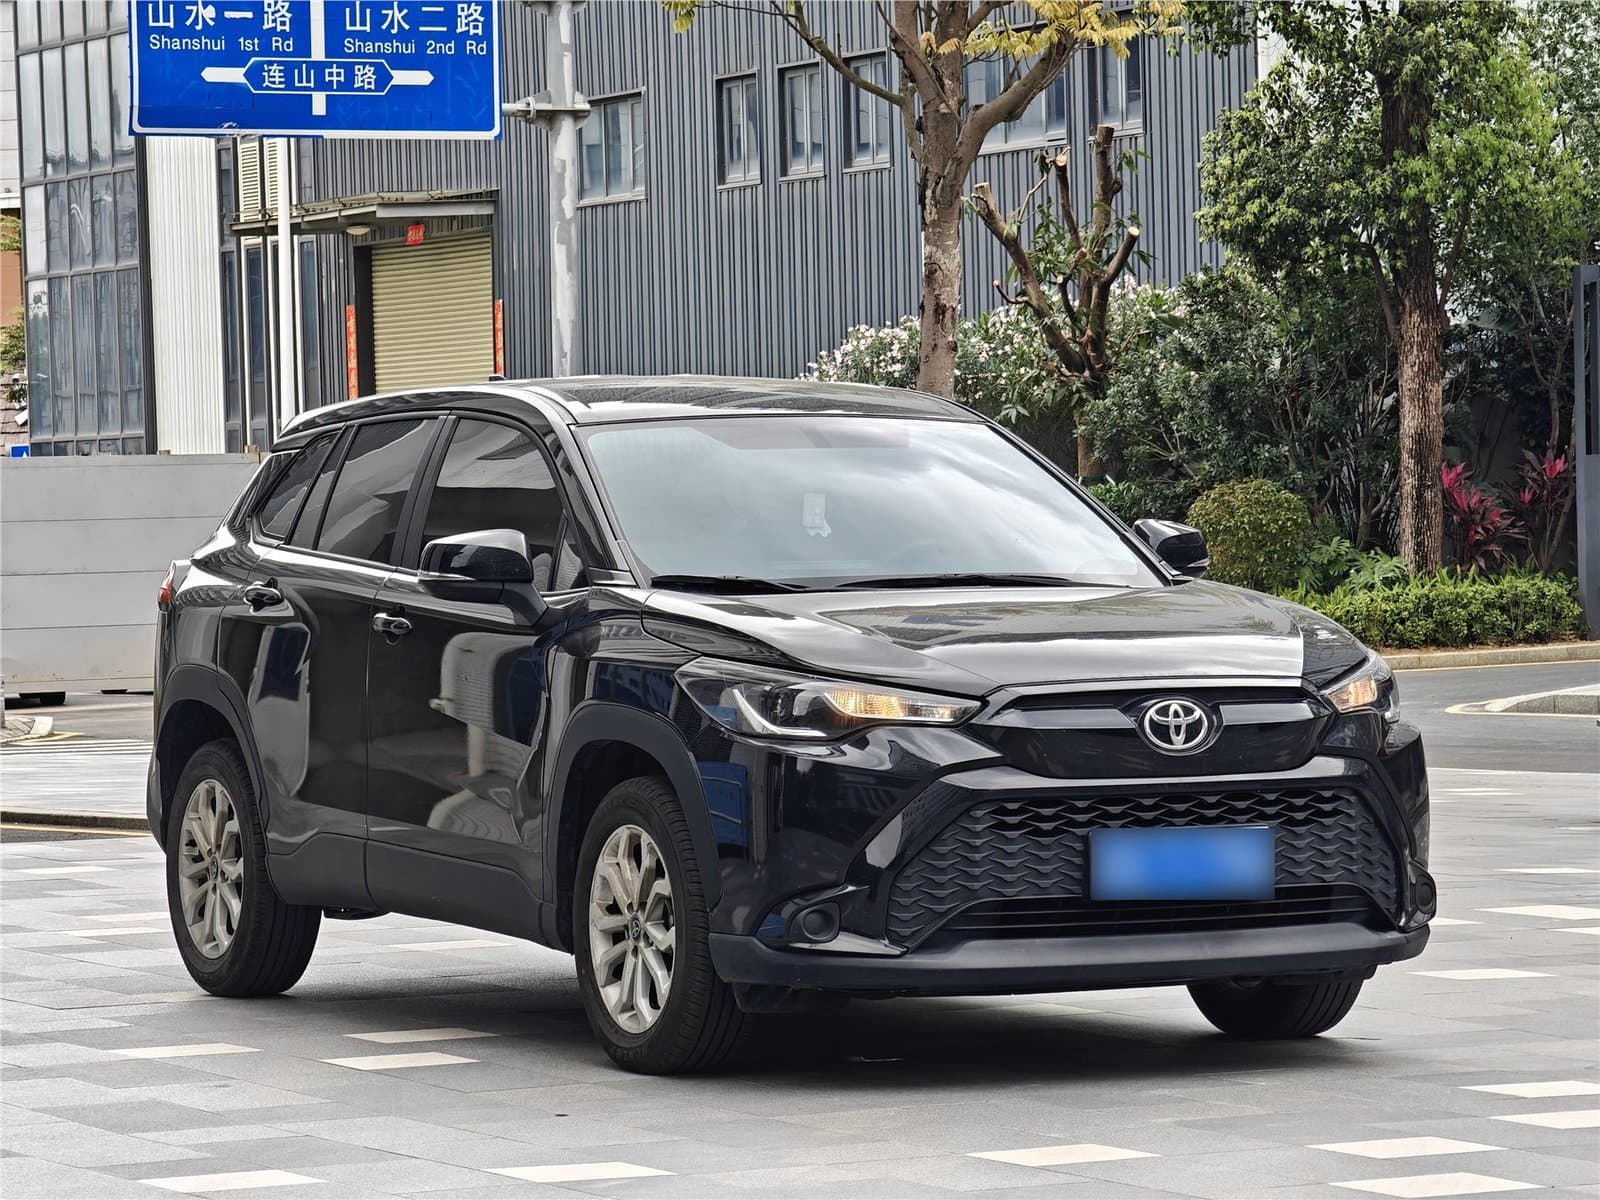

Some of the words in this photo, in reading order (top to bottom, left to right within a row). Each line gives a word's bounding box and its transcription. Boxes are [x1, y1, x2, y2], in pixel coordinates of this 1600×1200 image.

[148, 0, 293, 33] 山水一路
[345, 1, 486, 36] 山水二路
[149, 34, 226, 51] Shanshui
[238, 37, 259, 52] 1st
[271, 37, 294, 52] Rd
[344, 38, 416, 55] Shanshui
[426, 41, 456, 56] 2nd
[466, 41, 488, 56] Rd
[262, 62, 377, 91] 连山中路
